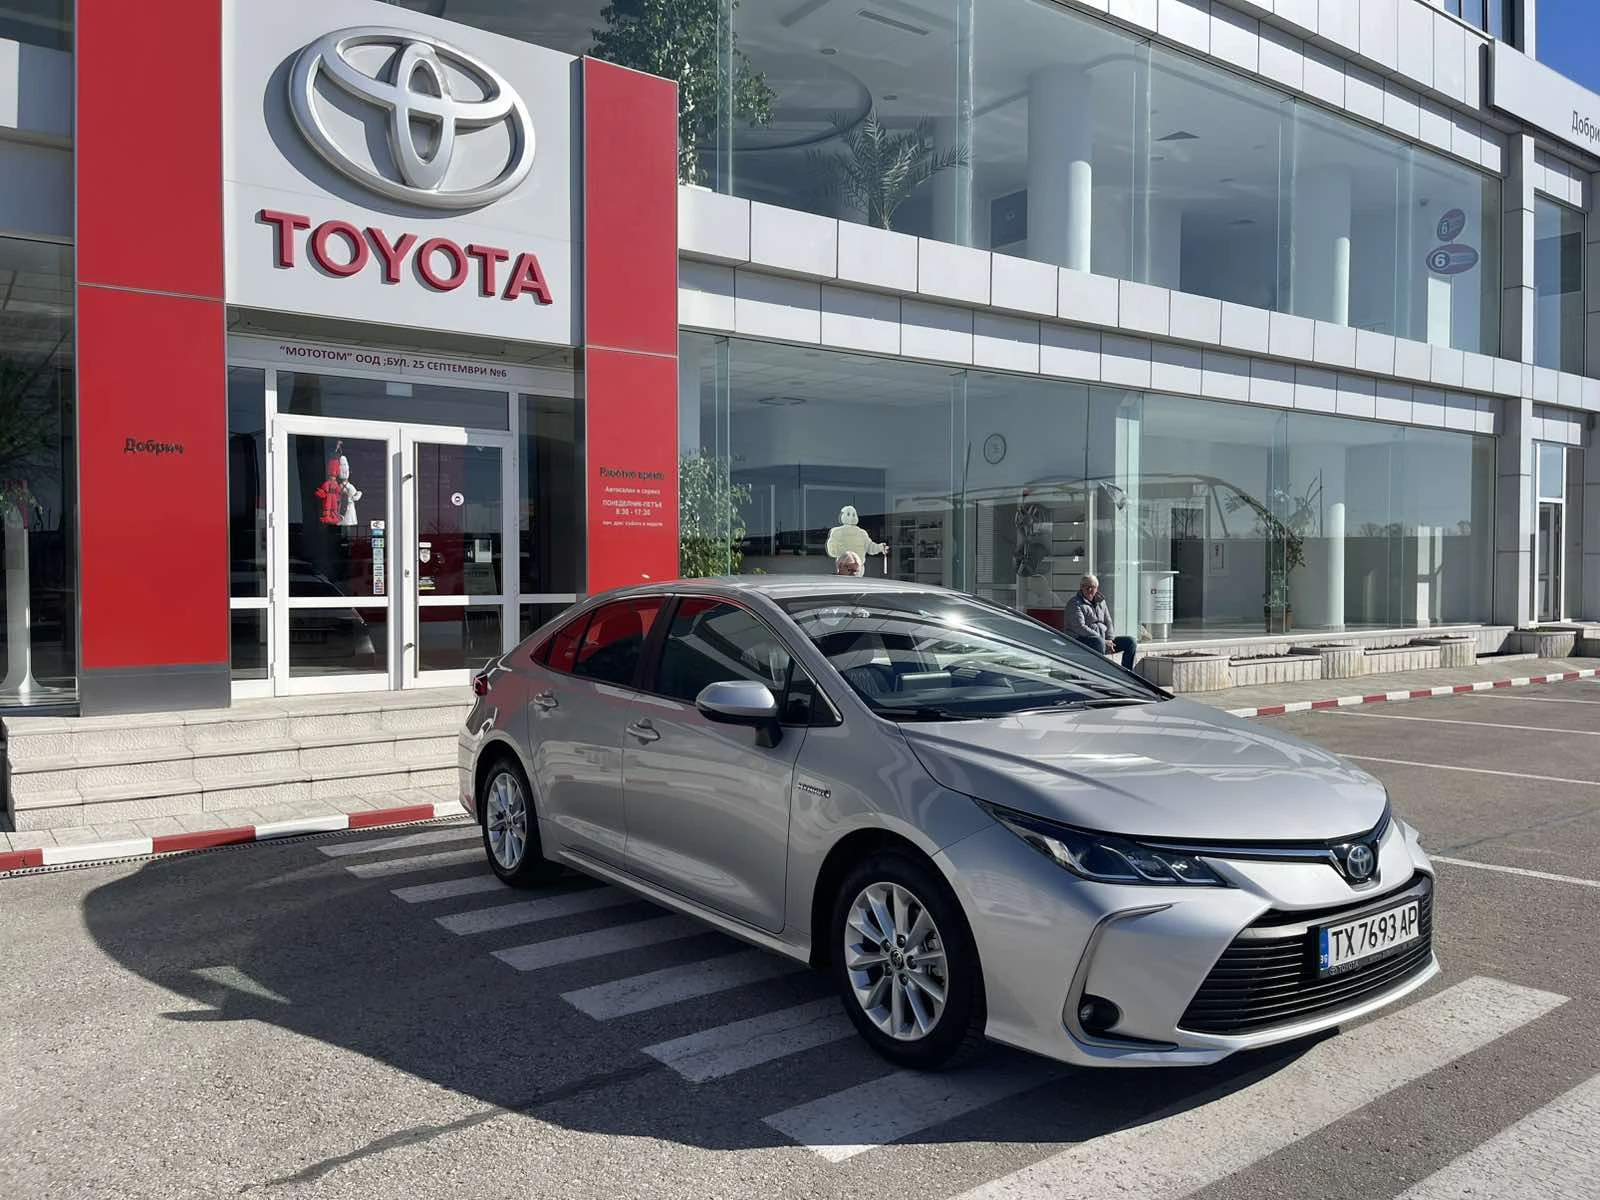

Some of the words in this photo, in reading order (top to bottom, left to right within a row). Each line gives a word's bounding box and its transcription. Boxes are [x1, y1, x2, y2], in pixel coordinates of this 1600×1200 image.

[257, 207, 553, 304] TOYOTA
[1435, 254, 1446, 267] 6
[355, 353, 381, 366] ООД
[412, 359, 425, 369] 25
[427, 361, 488, 376] СЕПТЕМВРИ
[489, 367, 507, 378] №6
[124, 437, 184, 456] Добрич
[1358, 913, 1397, 951] 7693
[1400, 905, 1417, 936] AP
